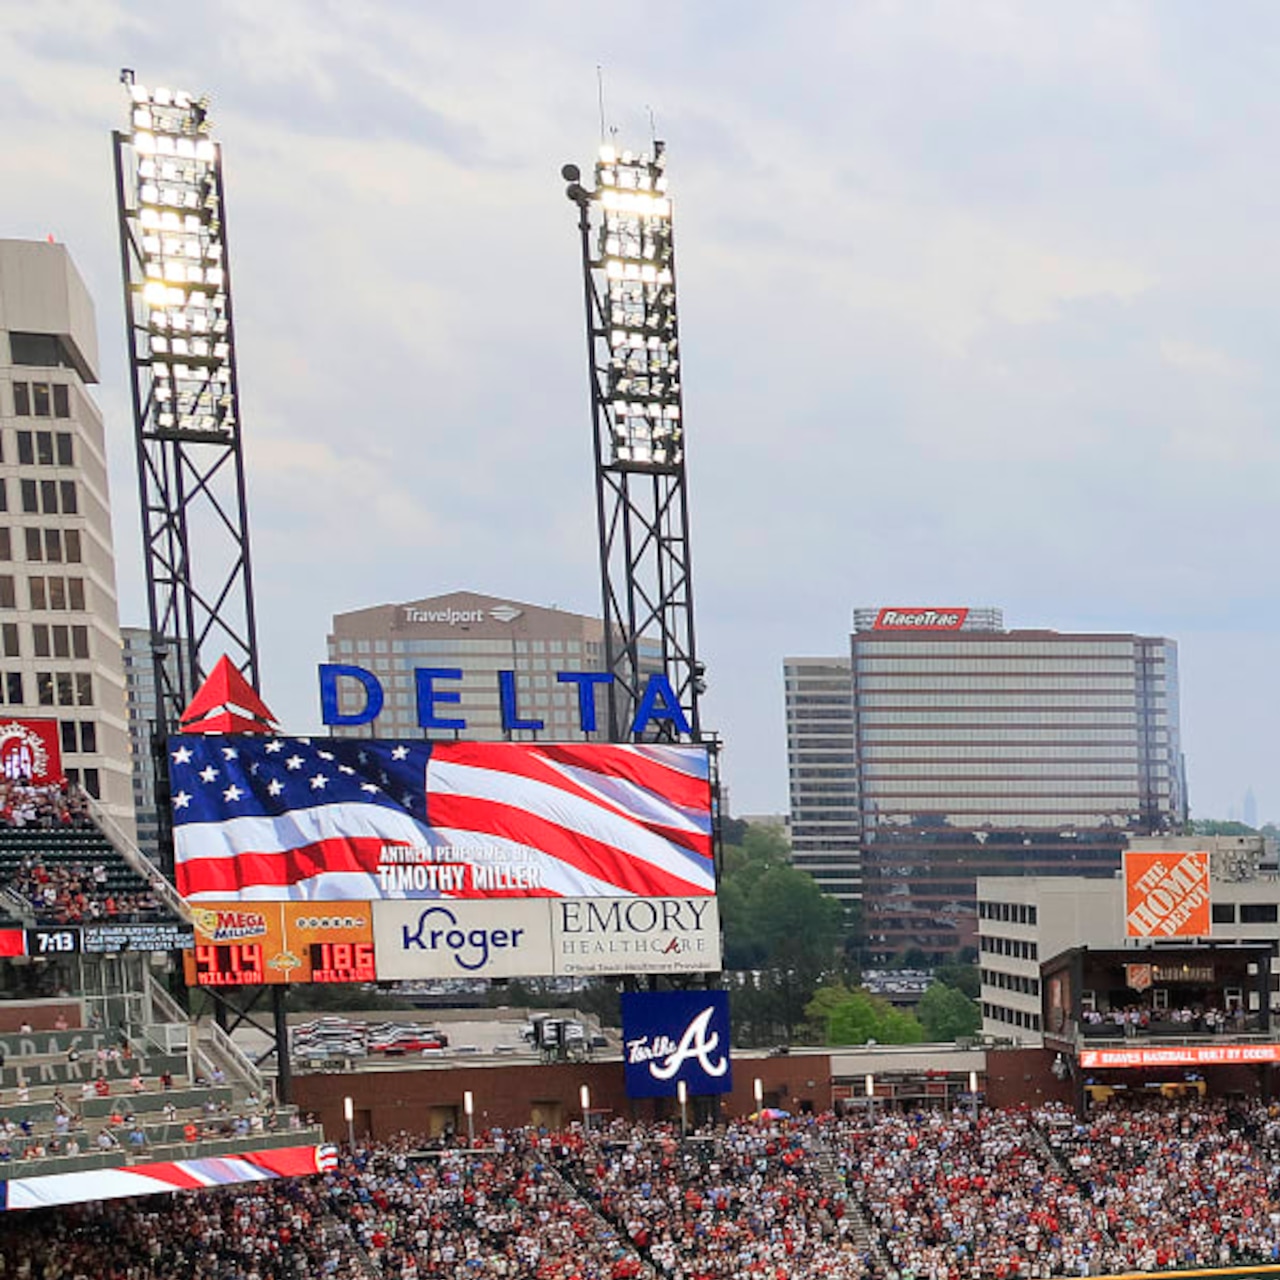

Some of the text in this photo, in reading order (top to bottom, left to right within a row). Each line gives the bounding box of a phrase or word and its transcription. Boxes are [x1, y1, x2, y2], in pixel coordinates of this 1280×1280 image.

[404, 606, 484, 626] Travelport
[880, 610, 960, 628] RaceTrac
[319, 663, 693, 734] DELTA
[377, 865, 541, 890] TIMOTHY MILLER
[1133, 859, 1169, 894] THE
[1128, 853, 1209, 936] HOME
[217, 911, 265, 928] MEGA
[562, 900, 711, 934] EMORY
[1160, 887, 1209, 937] DEPOT
[37, 933, 74, 951] 7:13
[402, 906, 524, 970] Kroger
[197, 972, 262, 984] MILLION
[312, 969, 375, 982] MILLION
[650, 1005, 728, 1079] A
[1102, 1052, 1141, 1064] BRAVES
